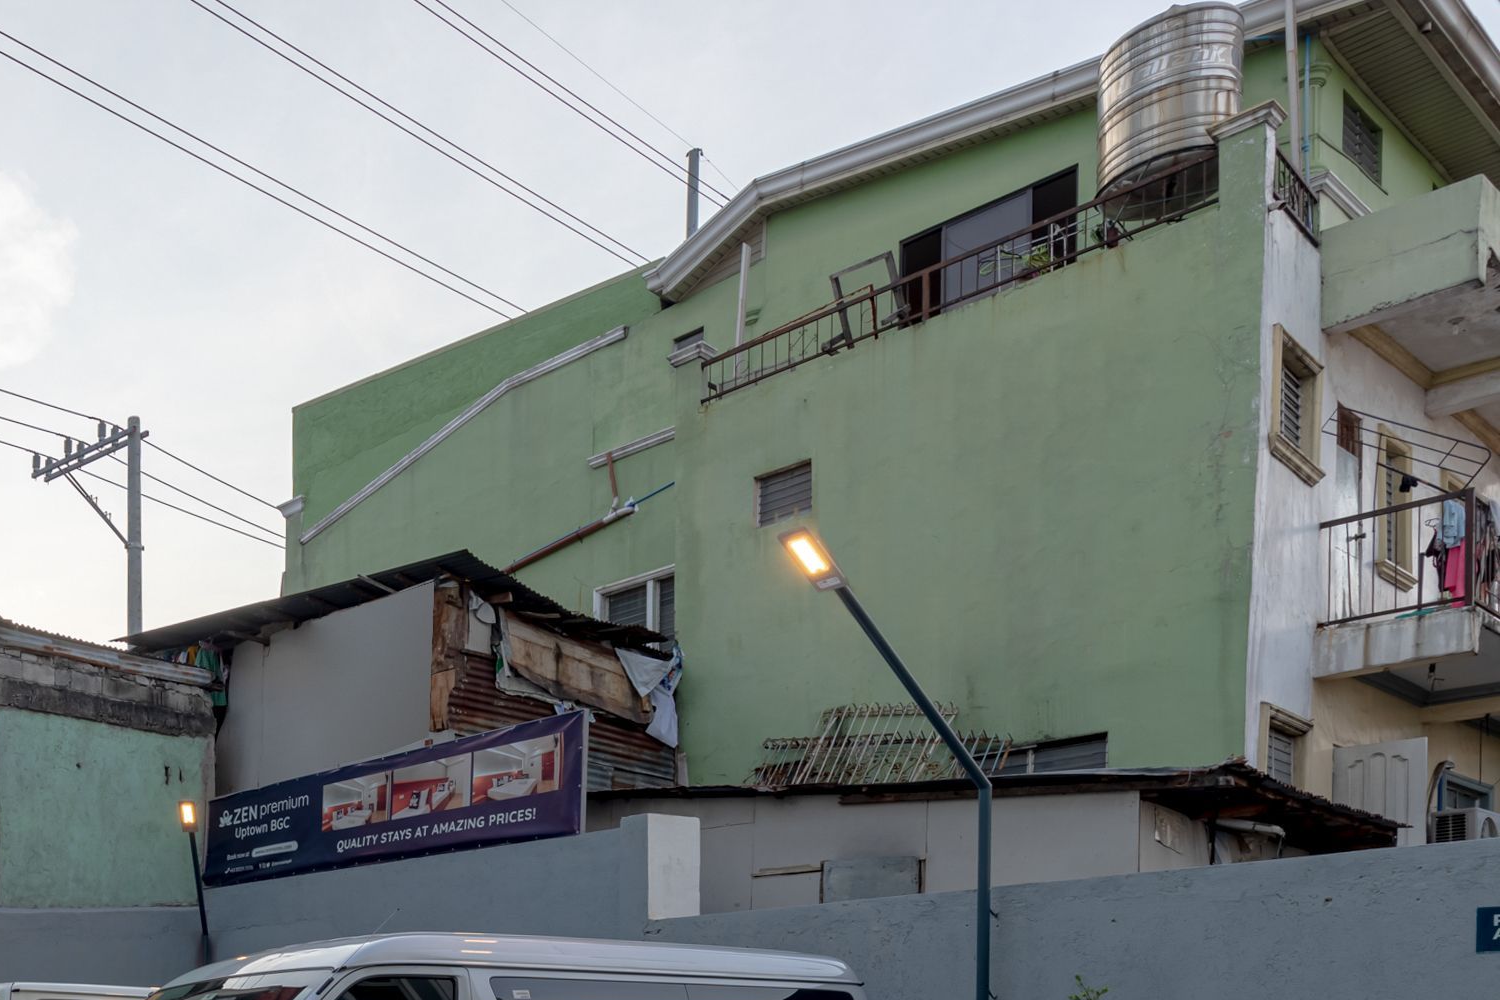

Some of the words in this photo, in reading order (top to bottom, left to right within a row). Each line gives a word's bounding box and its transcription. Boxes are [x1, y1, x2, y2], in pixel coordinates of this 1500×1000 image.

[233, 805, 258, 825] ZEN
[259, 794, 309, 819] premium
[235, 823, 268, 840] Uptown
[270, 816, 290, 832] BGC
[336, 833, 379, 853] QUALITY
[380, 828, 412, 844] STAYS
[414, 825, 429, 838] AT
[431, 816, 485, 836] AMAZING
[488, 807, 537, 826] PRICES!
